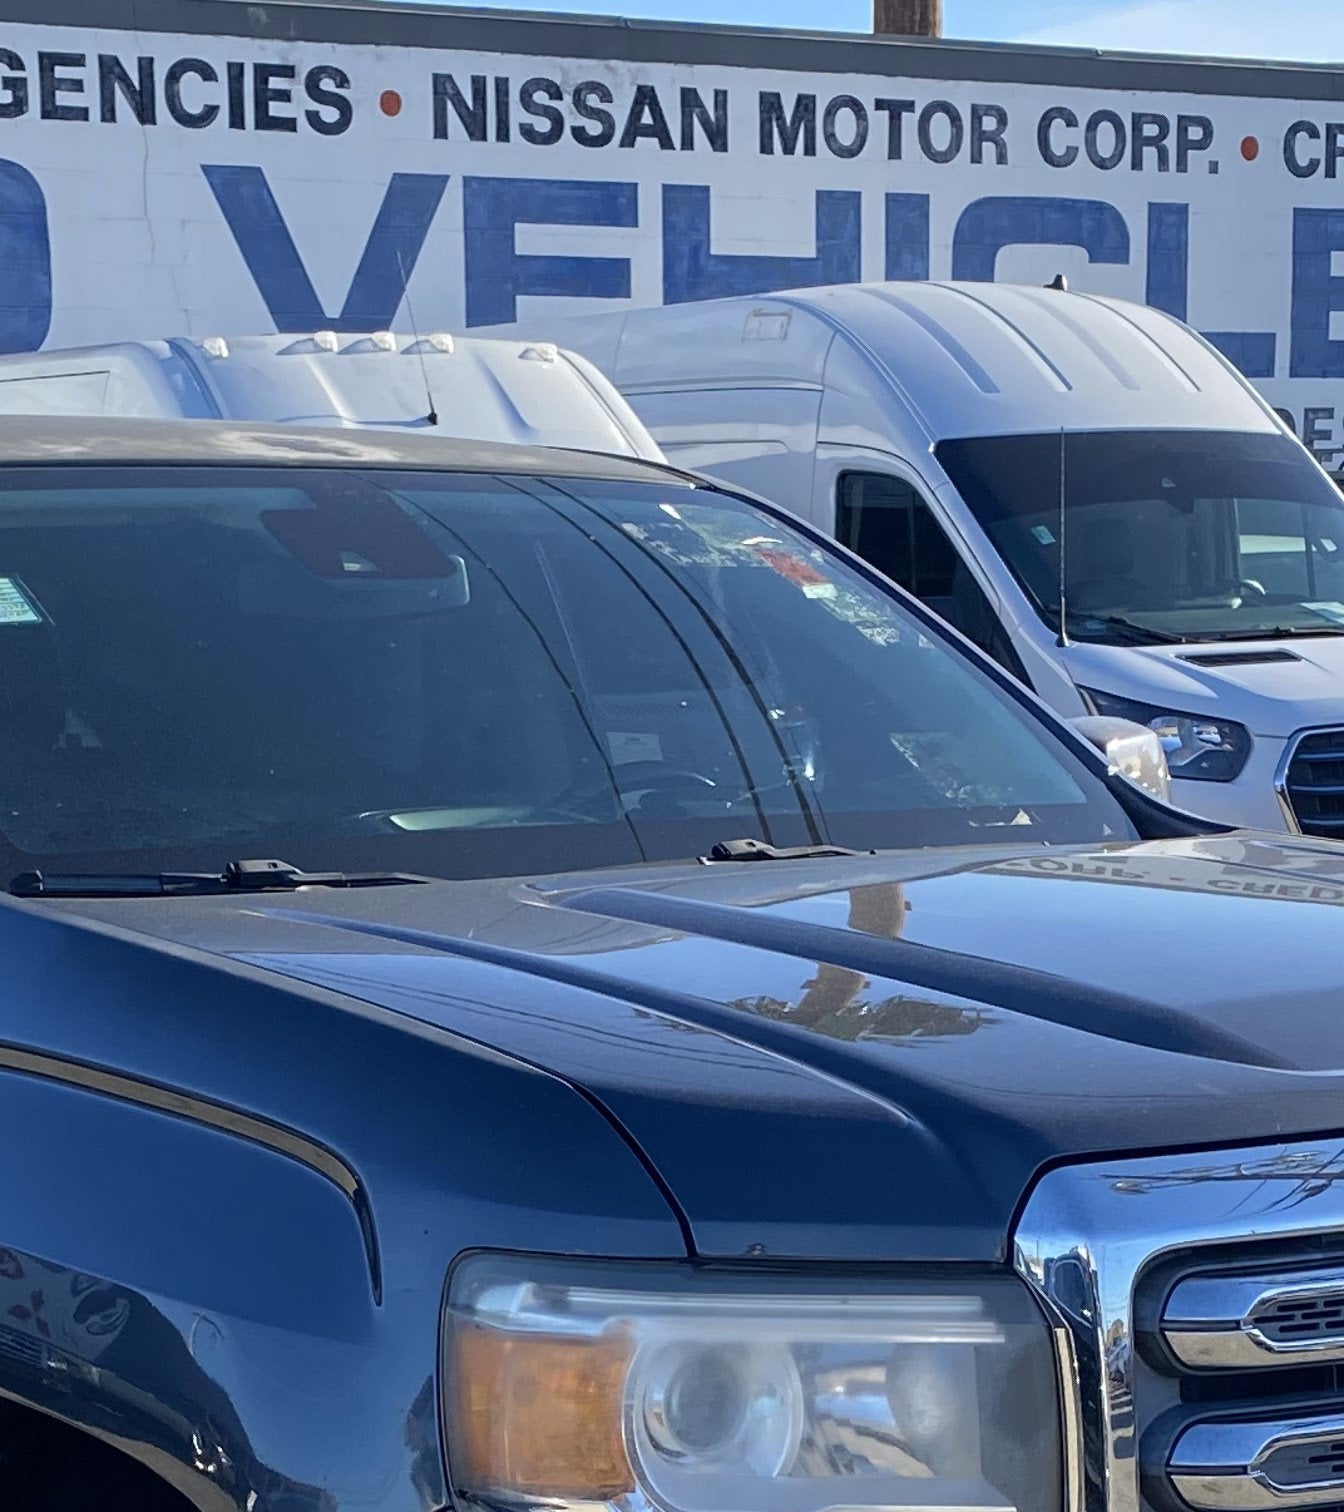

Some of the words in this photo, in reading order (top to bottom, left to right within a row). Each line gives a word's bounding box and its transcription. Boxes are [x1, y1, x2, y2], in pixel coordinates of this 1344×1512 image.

[432, 72, 729, 153] NISSAN
[759, 90, 1008, 165] MOTOR
[1037, 106, 1219, 175] CORP.
